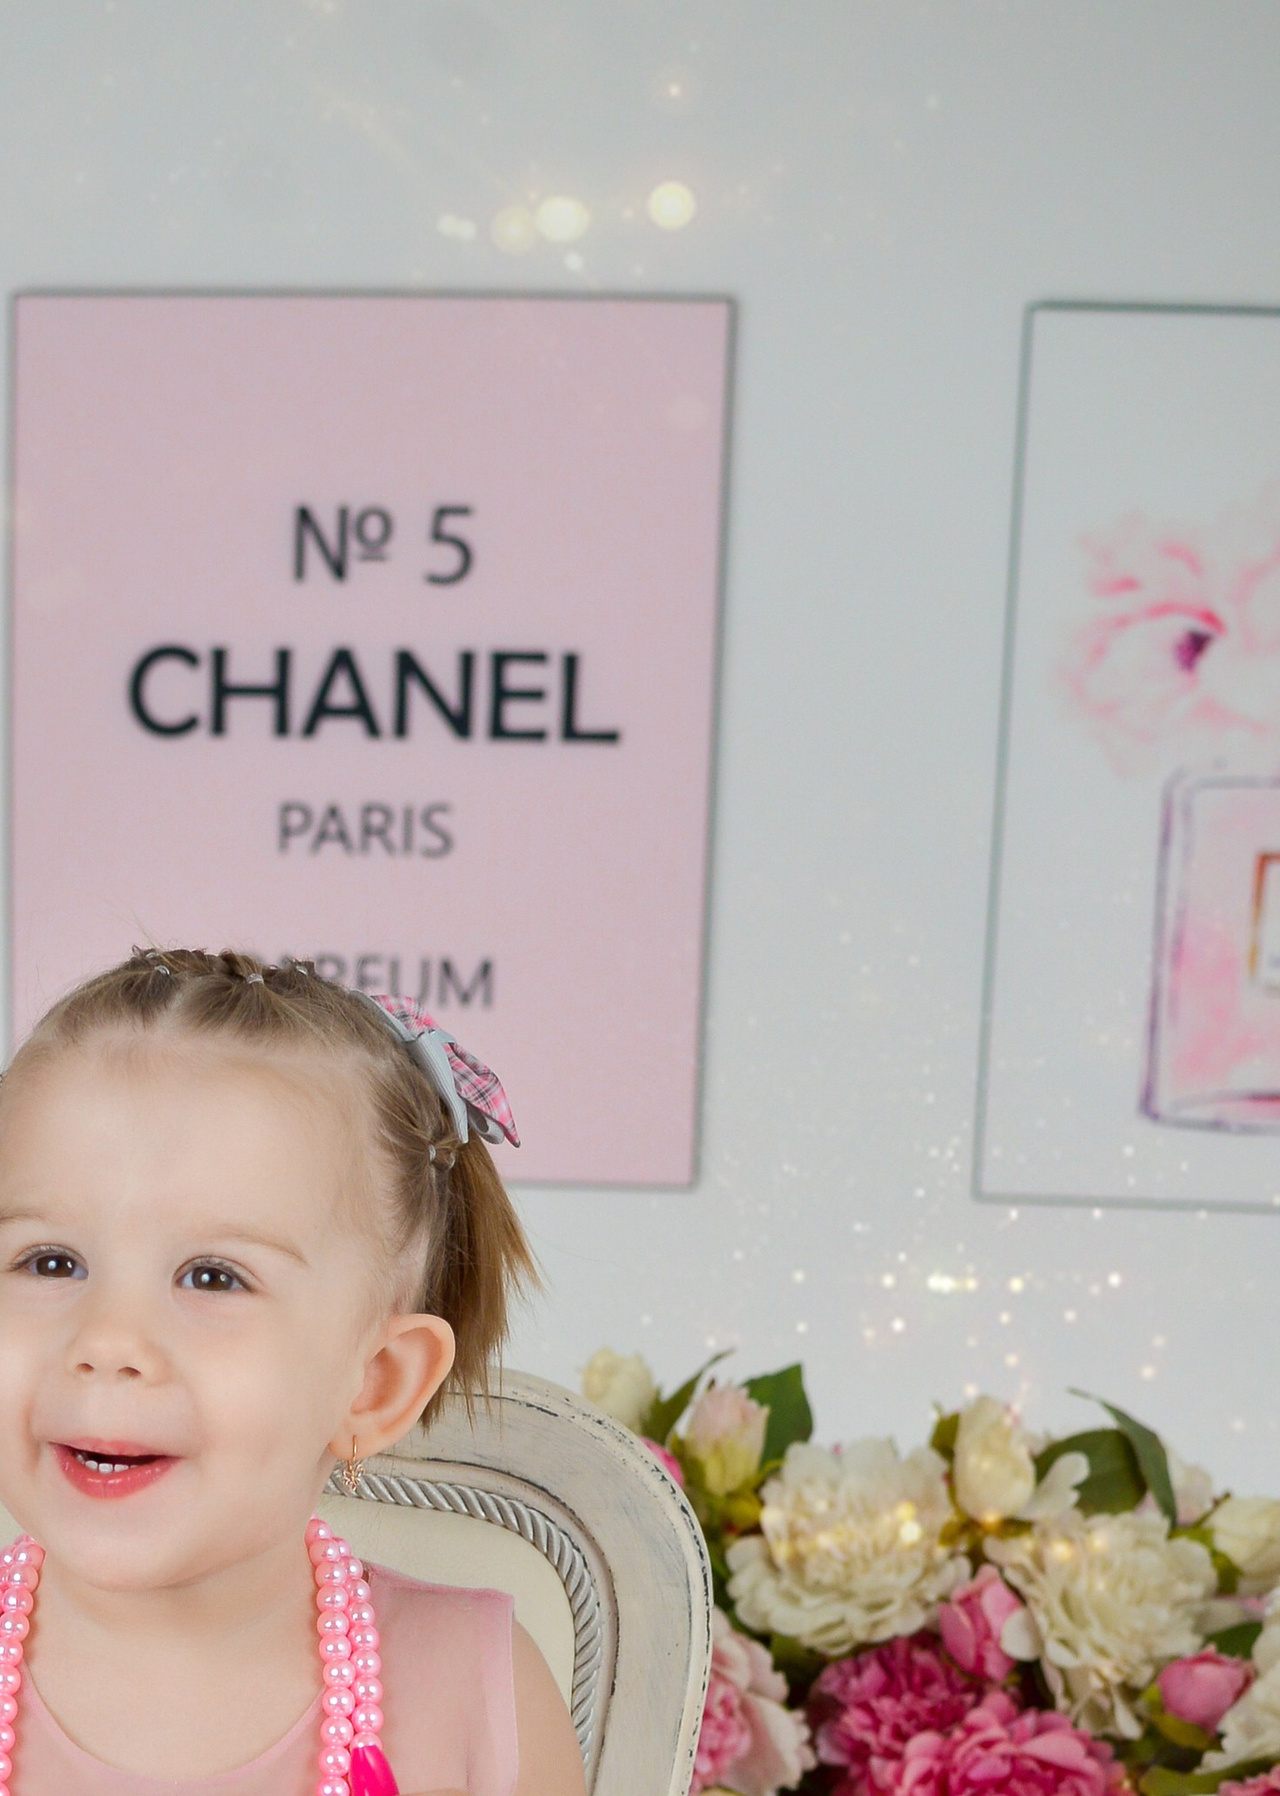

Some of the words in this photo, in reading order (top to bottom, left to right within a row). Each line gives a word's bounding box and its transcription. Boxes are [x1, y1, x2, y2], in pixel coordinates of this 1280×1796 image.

[424, 504, 475, 585] 5
[127, 643, 622, 744] CHANEL
[276, 800, 456, 859] PARIS
[243, 952, 496, 1010] RFUM
